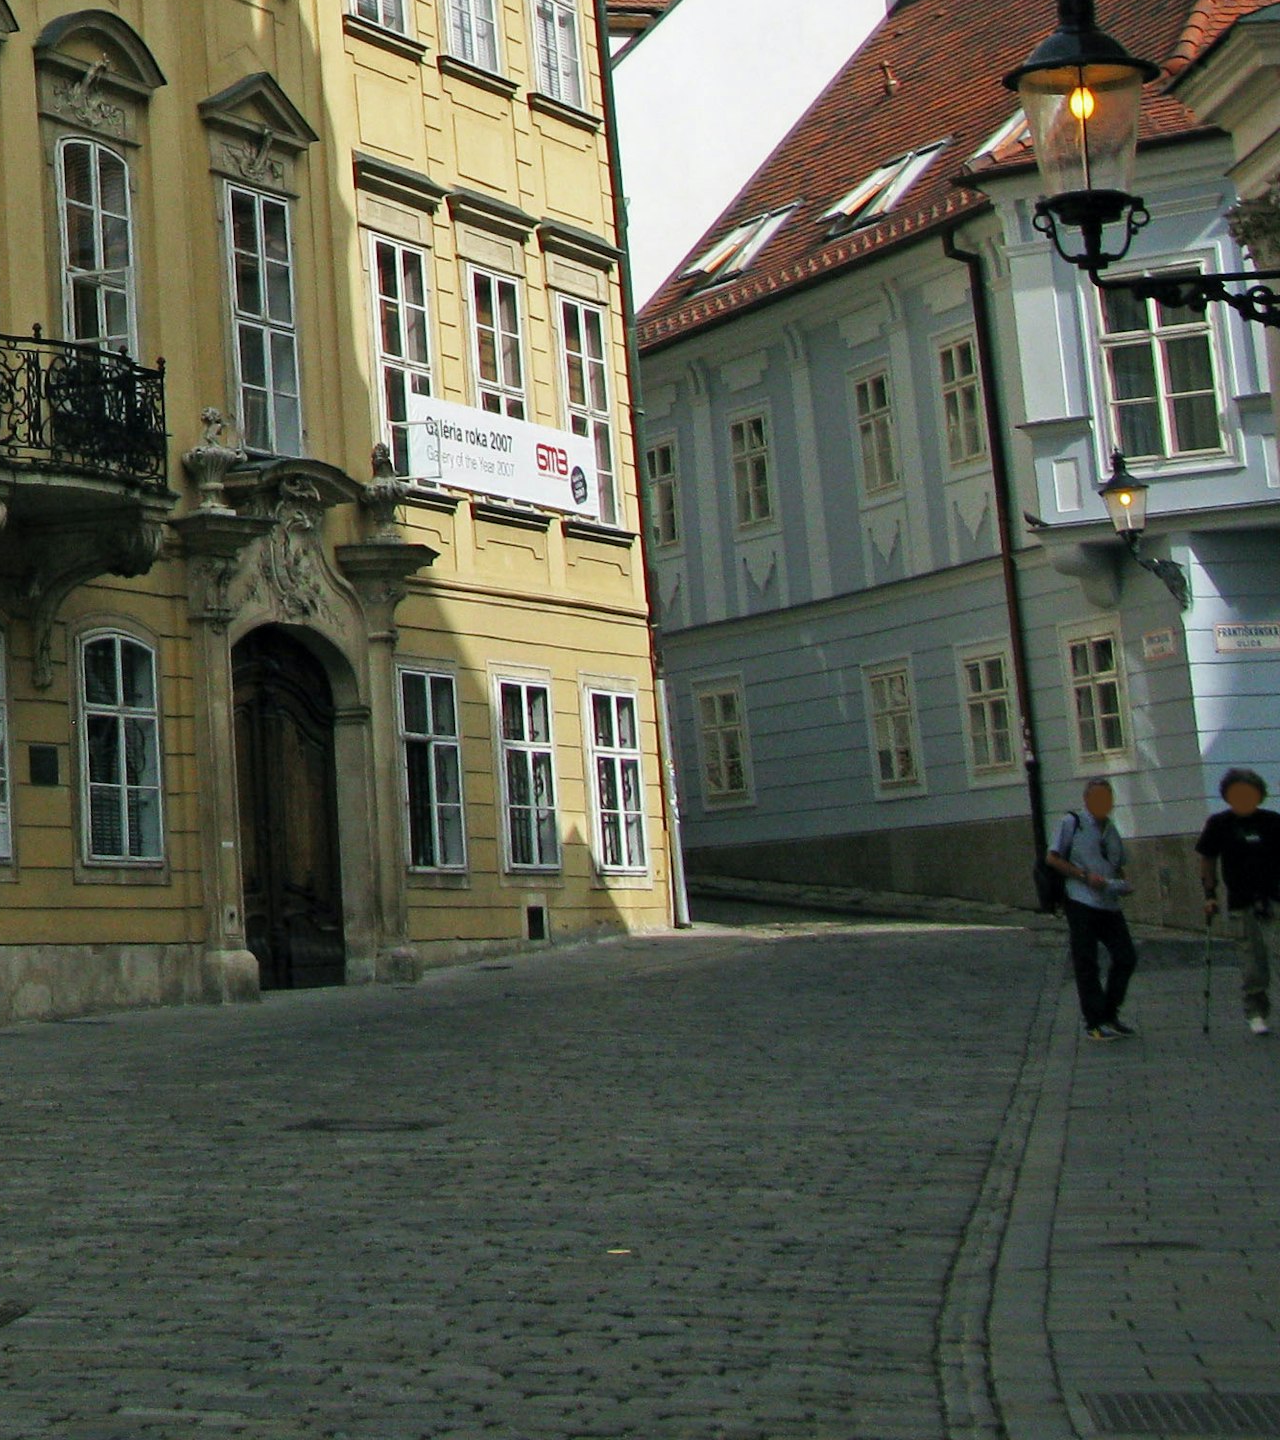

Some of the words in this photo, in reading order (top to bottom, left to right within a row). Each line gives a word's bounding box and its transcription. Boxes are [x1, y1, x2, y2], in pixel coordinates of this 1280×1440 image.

[426, 416, 462, 442] Galéria
[465, 428, 487, 447] roka
[490, 431, 512, 453] 2007
